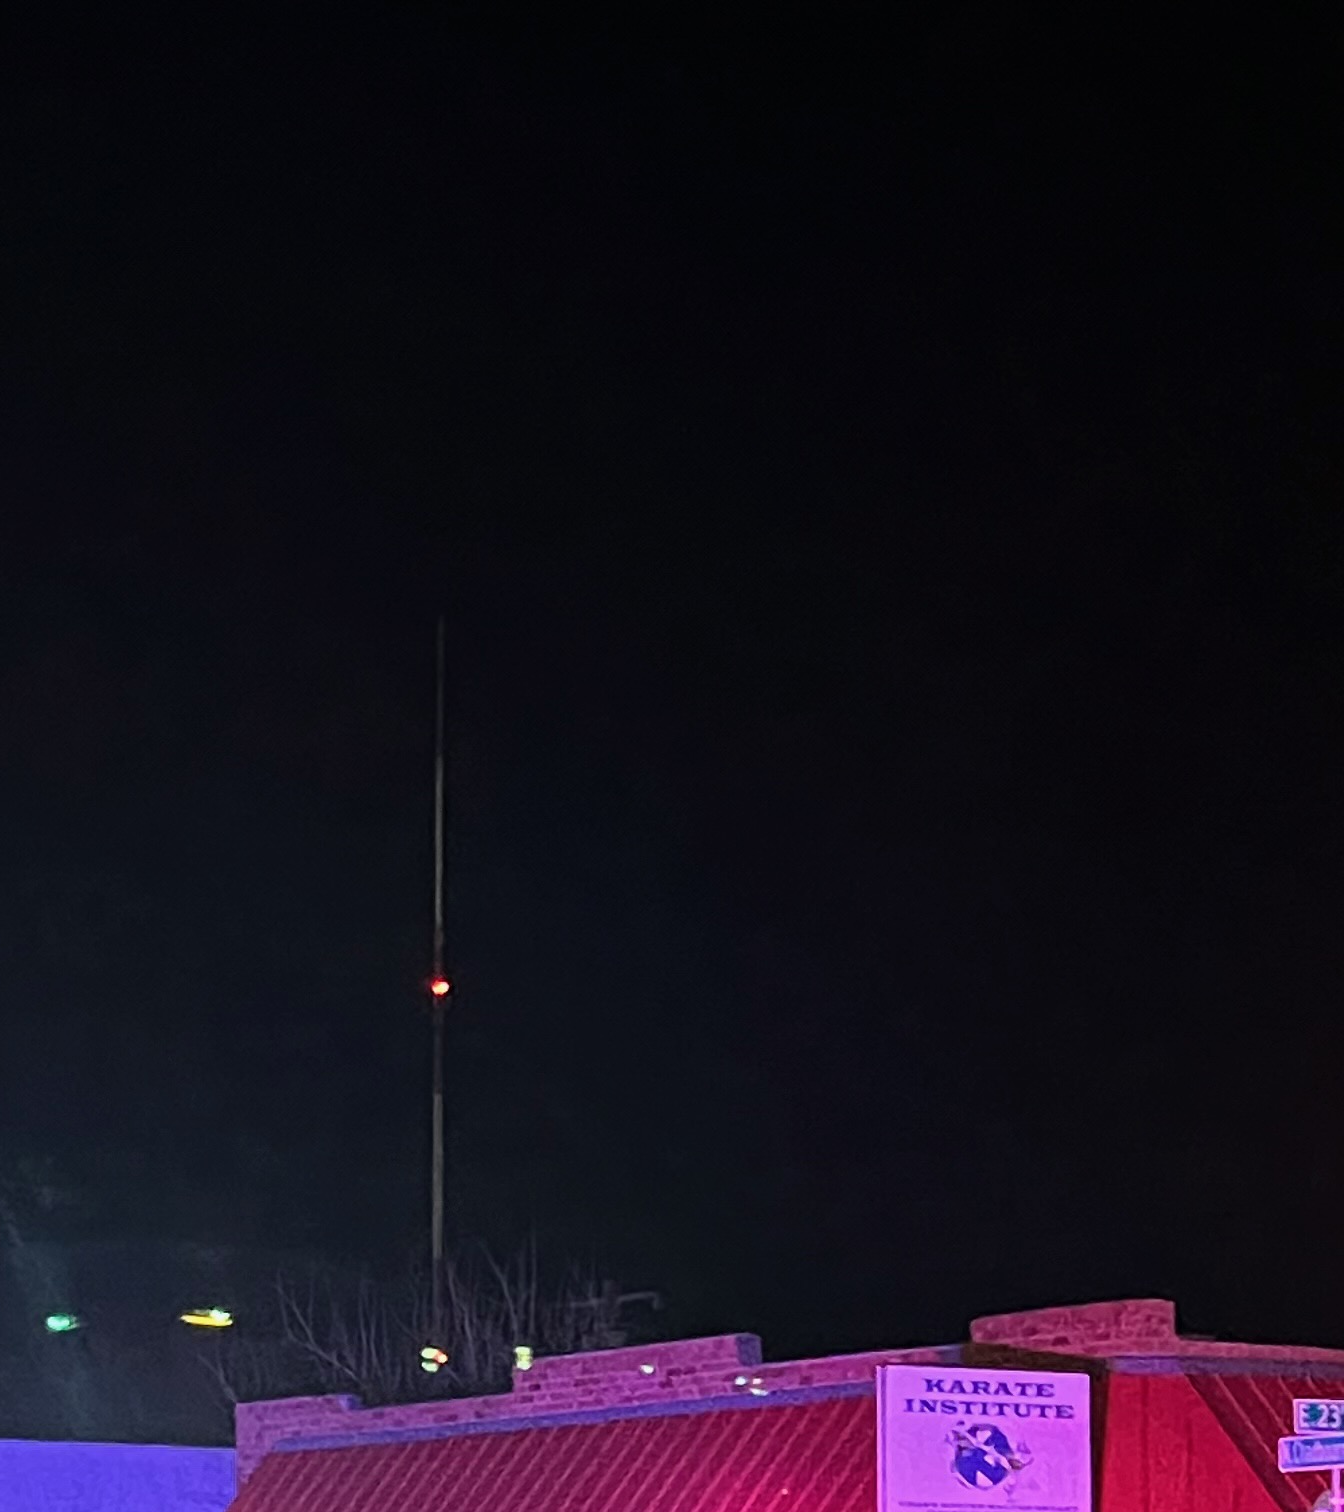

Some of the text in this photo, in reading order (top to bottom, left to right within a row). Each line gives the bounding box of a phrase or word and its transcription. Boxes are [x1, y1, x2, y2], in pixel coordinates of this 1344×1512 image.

[924, 1378, 1055, 1398] KARATE
[903, 1398, 1074, 1419] INSTITUTE
[1317, 1404, 1344, 1428] 23
